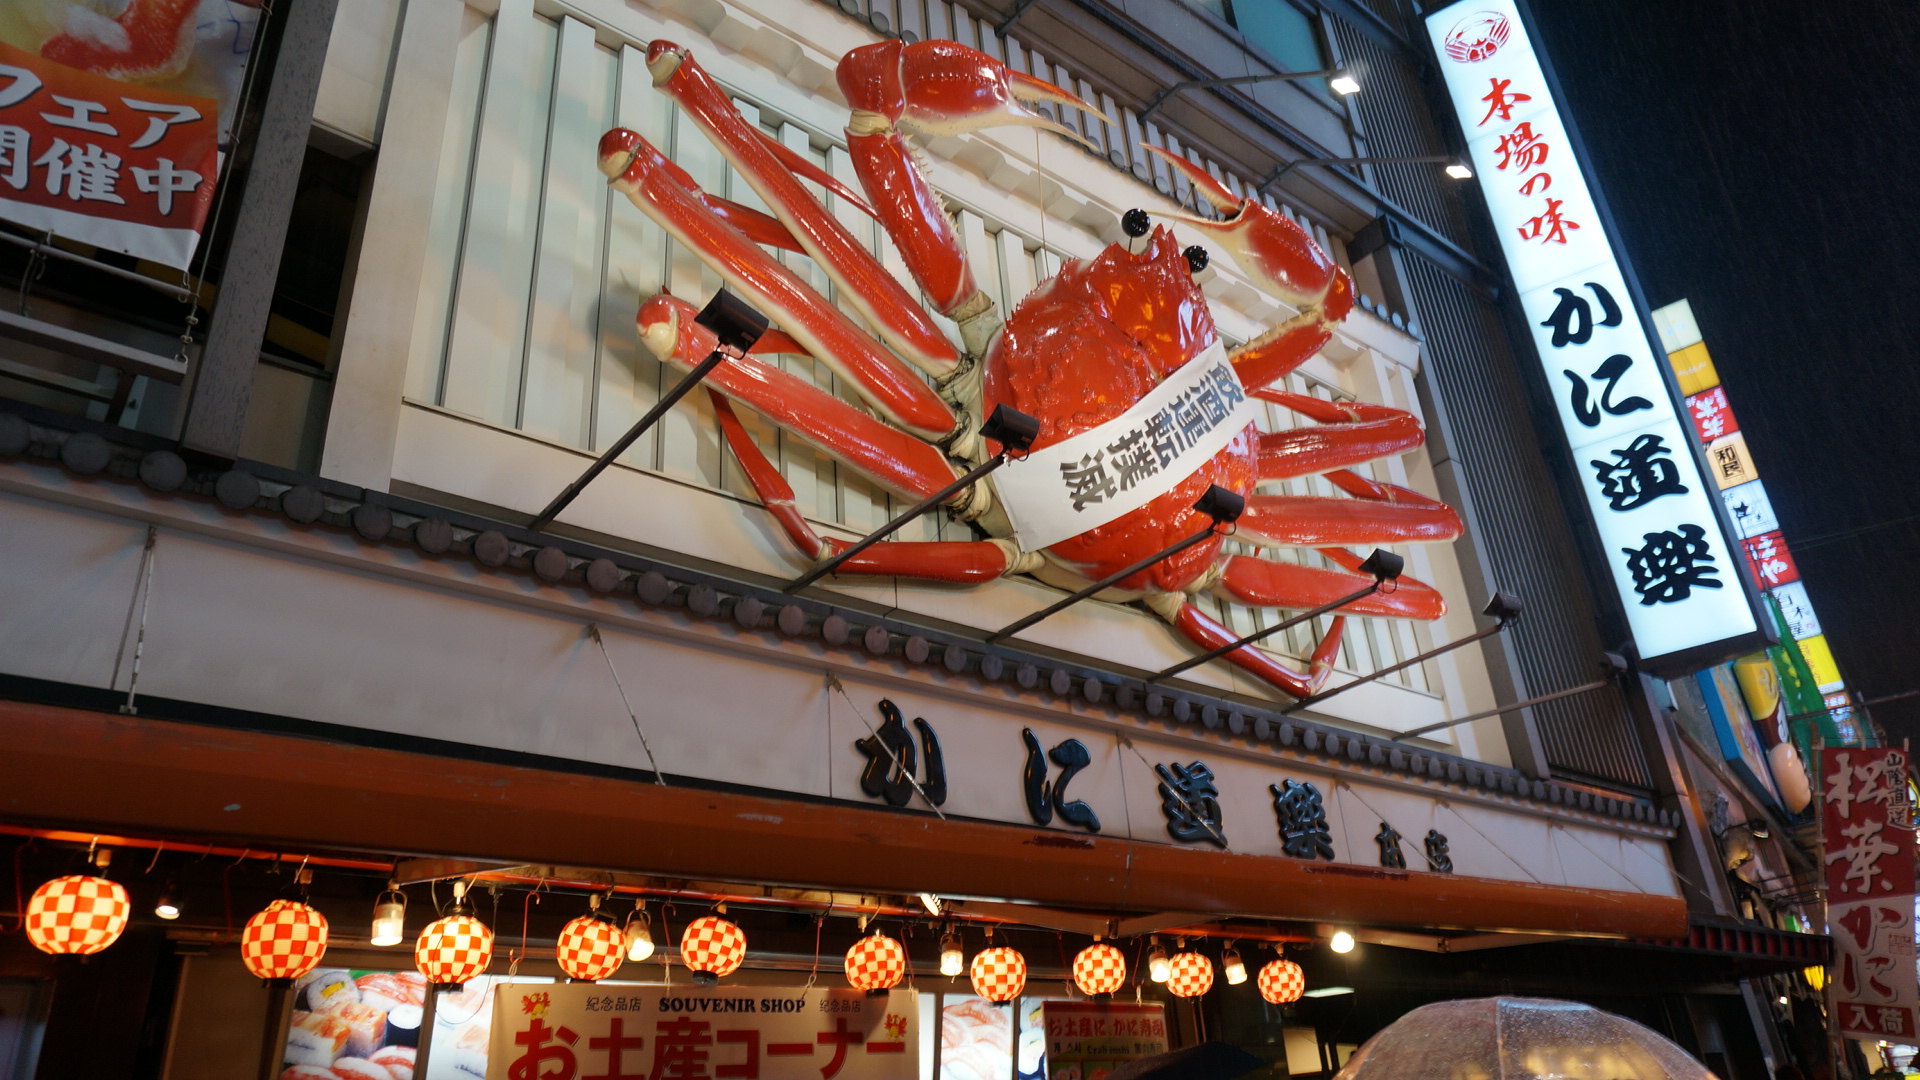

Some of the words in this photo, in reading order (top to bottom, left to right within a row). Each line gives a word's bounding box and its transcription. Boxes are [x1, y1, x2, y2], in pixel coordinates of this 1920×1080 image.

[1478, 78, 1580, 245] 本場の味
[1059, 361, 1244, 513] 飲酒運転撲滅
[1717, 447, 1742, 477] 和民
[658, 997, 757, 1013] SOUVENIR
[760, 998, 805, 1014] SHOP
[1849, 1005, 1904, 1035] 入荷
[507, 1015, 907, 1080] お土産コーナー
